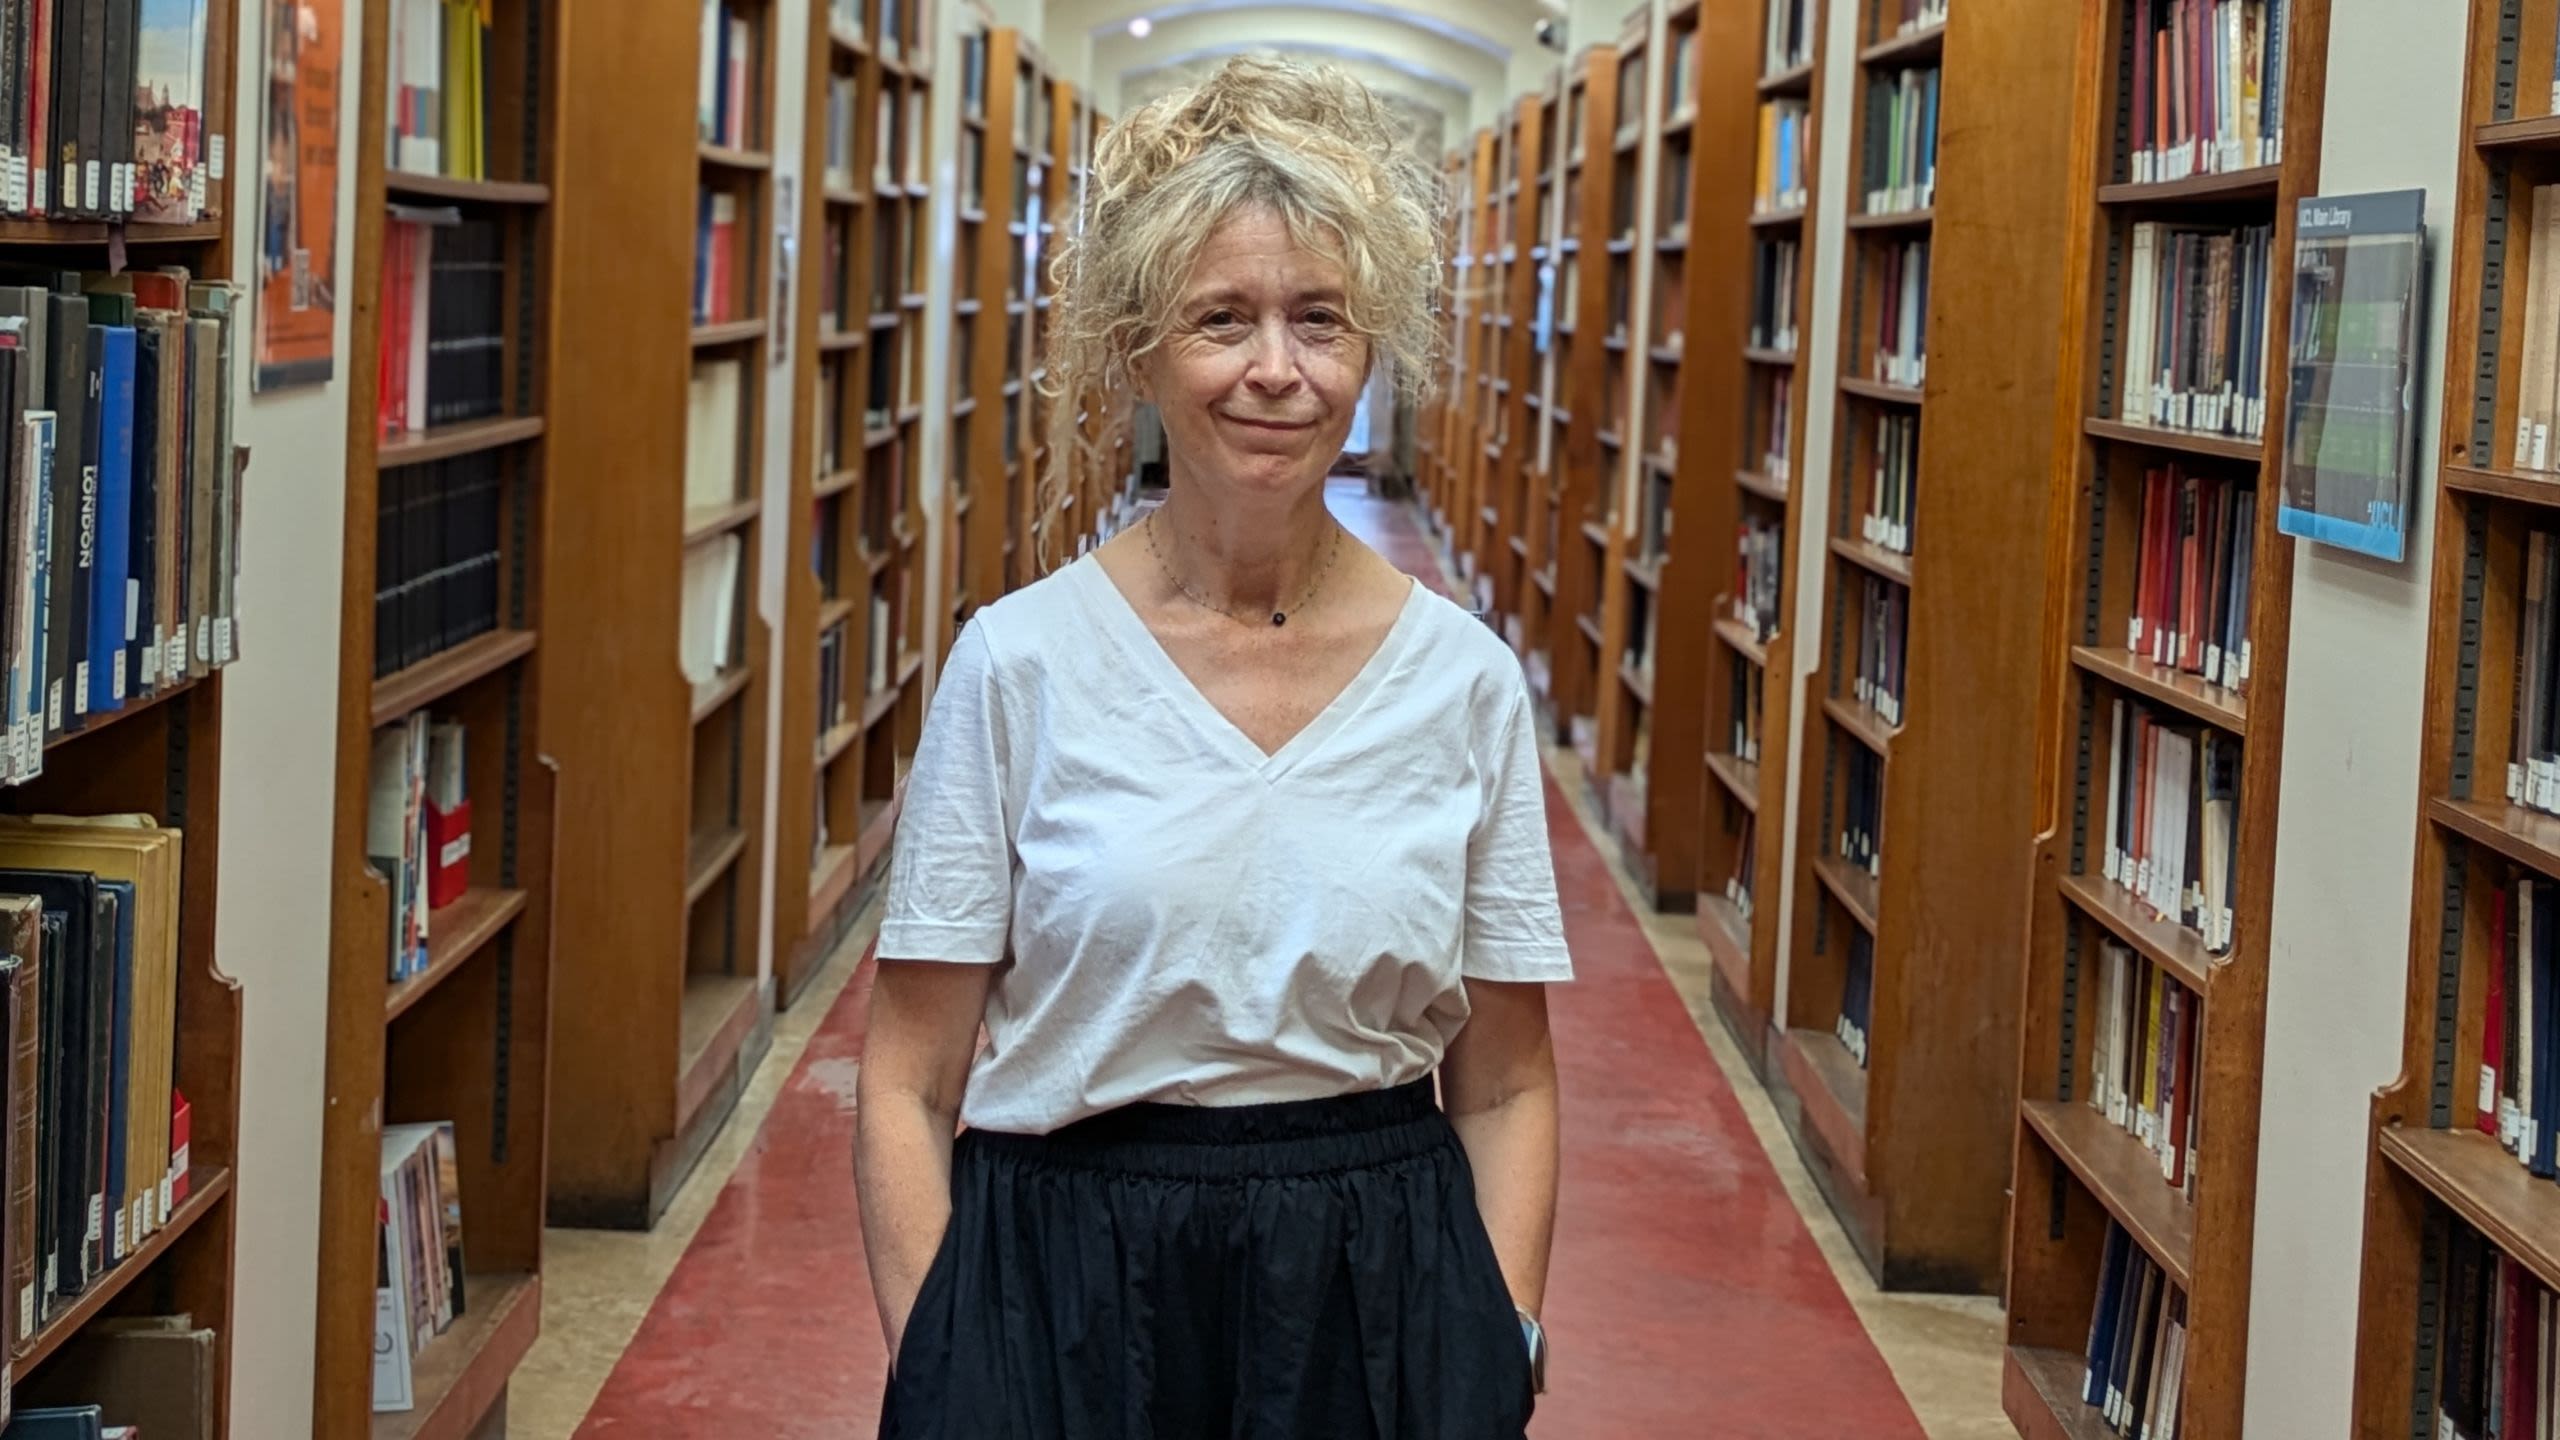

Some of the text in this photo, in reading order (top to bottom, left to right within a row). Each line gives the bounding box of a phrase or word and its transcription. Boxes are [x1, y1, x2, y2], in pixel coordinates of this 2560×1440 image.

[2299, 206, 2352, 230] UCL Main Library
[79, 465, 94, 568] LONDON
[2371, 501, 2397, 532] UCL
